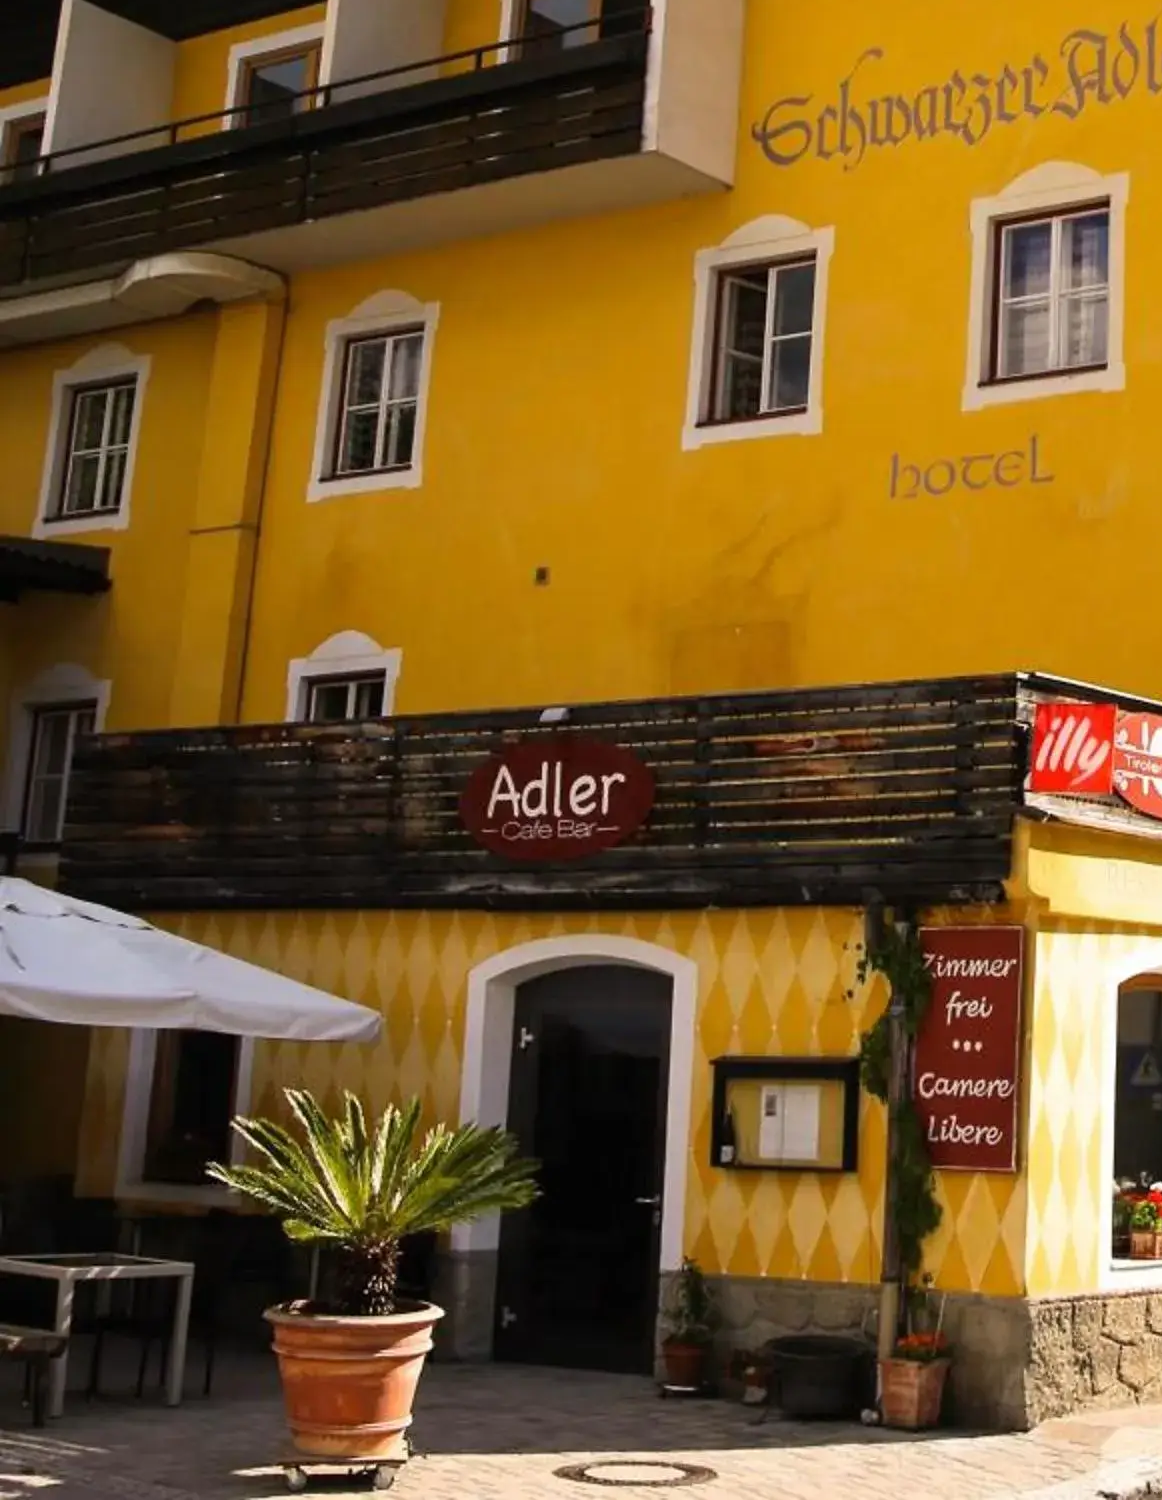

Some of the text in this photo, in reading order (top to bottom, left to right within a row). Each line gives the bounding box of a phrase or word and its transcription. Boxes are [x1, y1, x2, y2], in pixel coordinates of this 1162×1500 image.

[752, 48, 1049, 173] Schwarzer
[1034, 714, 1111, 787] illy
[487, 760, 627, 819] Adler
[501, 819, 597, 841] Cafe Bar
[945, 990, 994, 1026] frei
[918, 1072, 1015, 1099] Camere
[927, 1115, 1003, 1145] Libere
